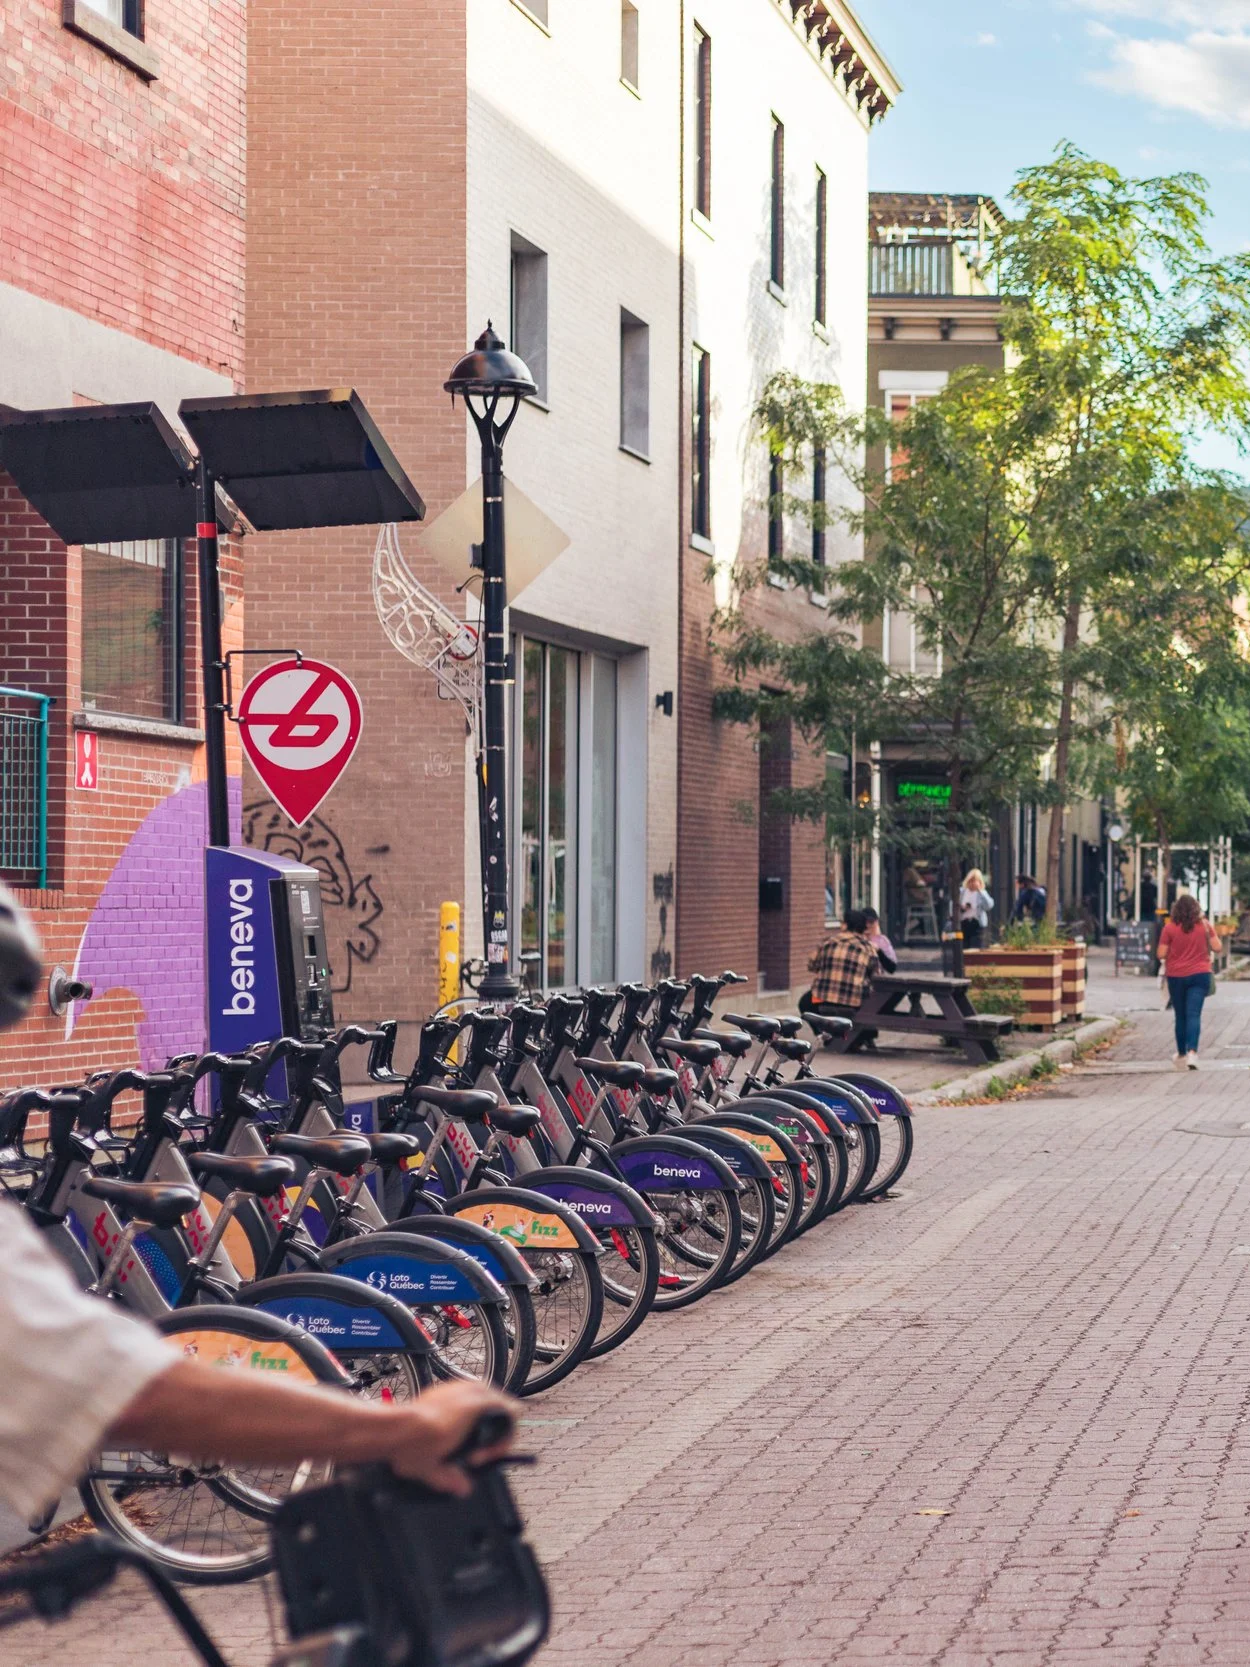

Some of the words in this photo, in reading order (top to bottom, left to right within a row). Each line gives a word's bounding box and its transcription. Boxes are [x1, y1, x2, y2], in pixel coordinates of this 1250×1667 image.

[222, 878, 256, 1016] beneva
[653, 1165, 701, 1178] beneva
[559, 1198, 611, 1214] beneva
[531, 1221, 559, 1236] fizz
[390, 1273, 410, 1282] Loto
[389, 1281, 425, 1290] Québec
[309, 1316, 330, 1325] Loto
[308, 1325, 346, 1335] Québec
[250, 1351, 289, 1370] fizz
